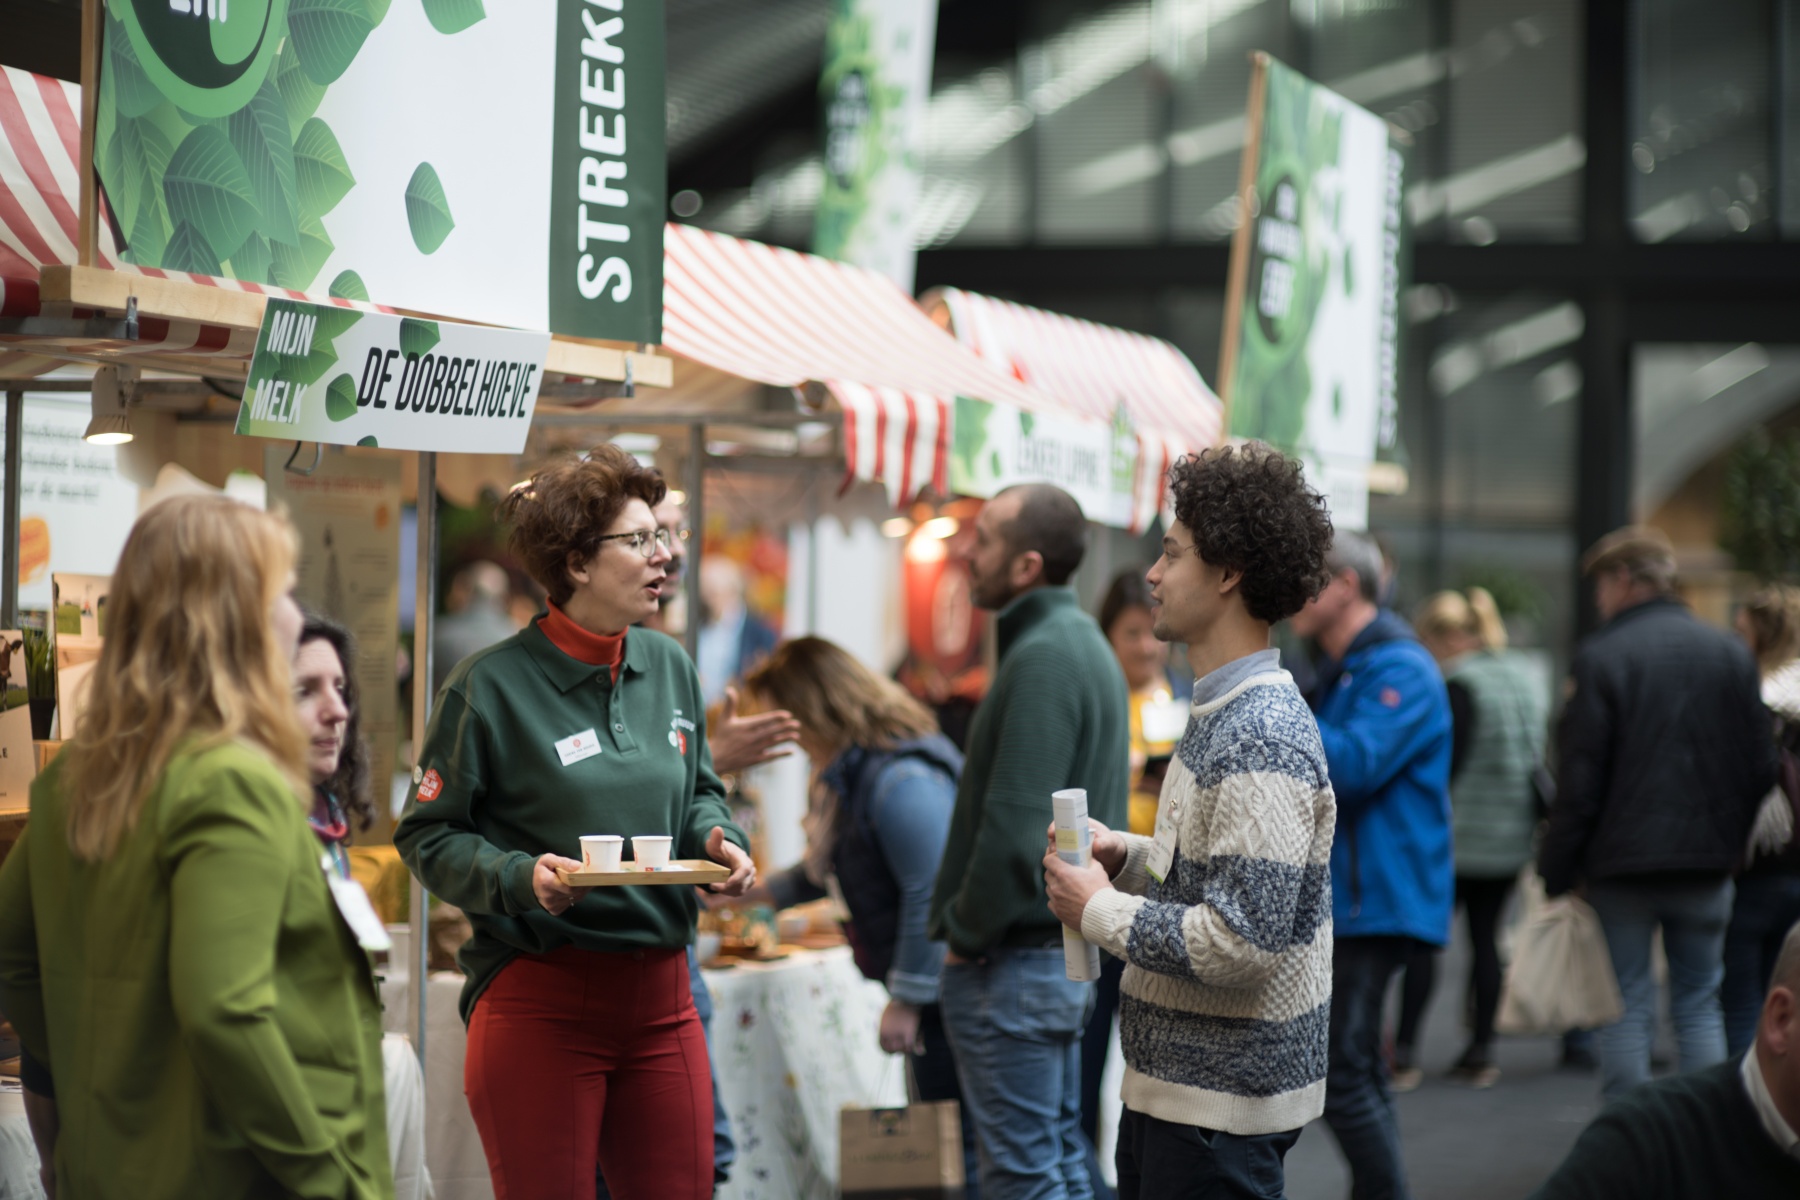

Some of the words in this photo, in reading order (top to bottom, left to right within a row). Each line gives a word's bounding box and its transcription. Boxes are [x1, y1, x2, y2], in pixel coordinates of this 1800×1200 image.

[577, 0, 632, 302] STREEK
[266, 310, 316, 356] MIJN
[249, 378, 307, 425] MELK
[356, 347, 399, 409] DE
[395, 352, 536, 418] DOBBELHOEVE
